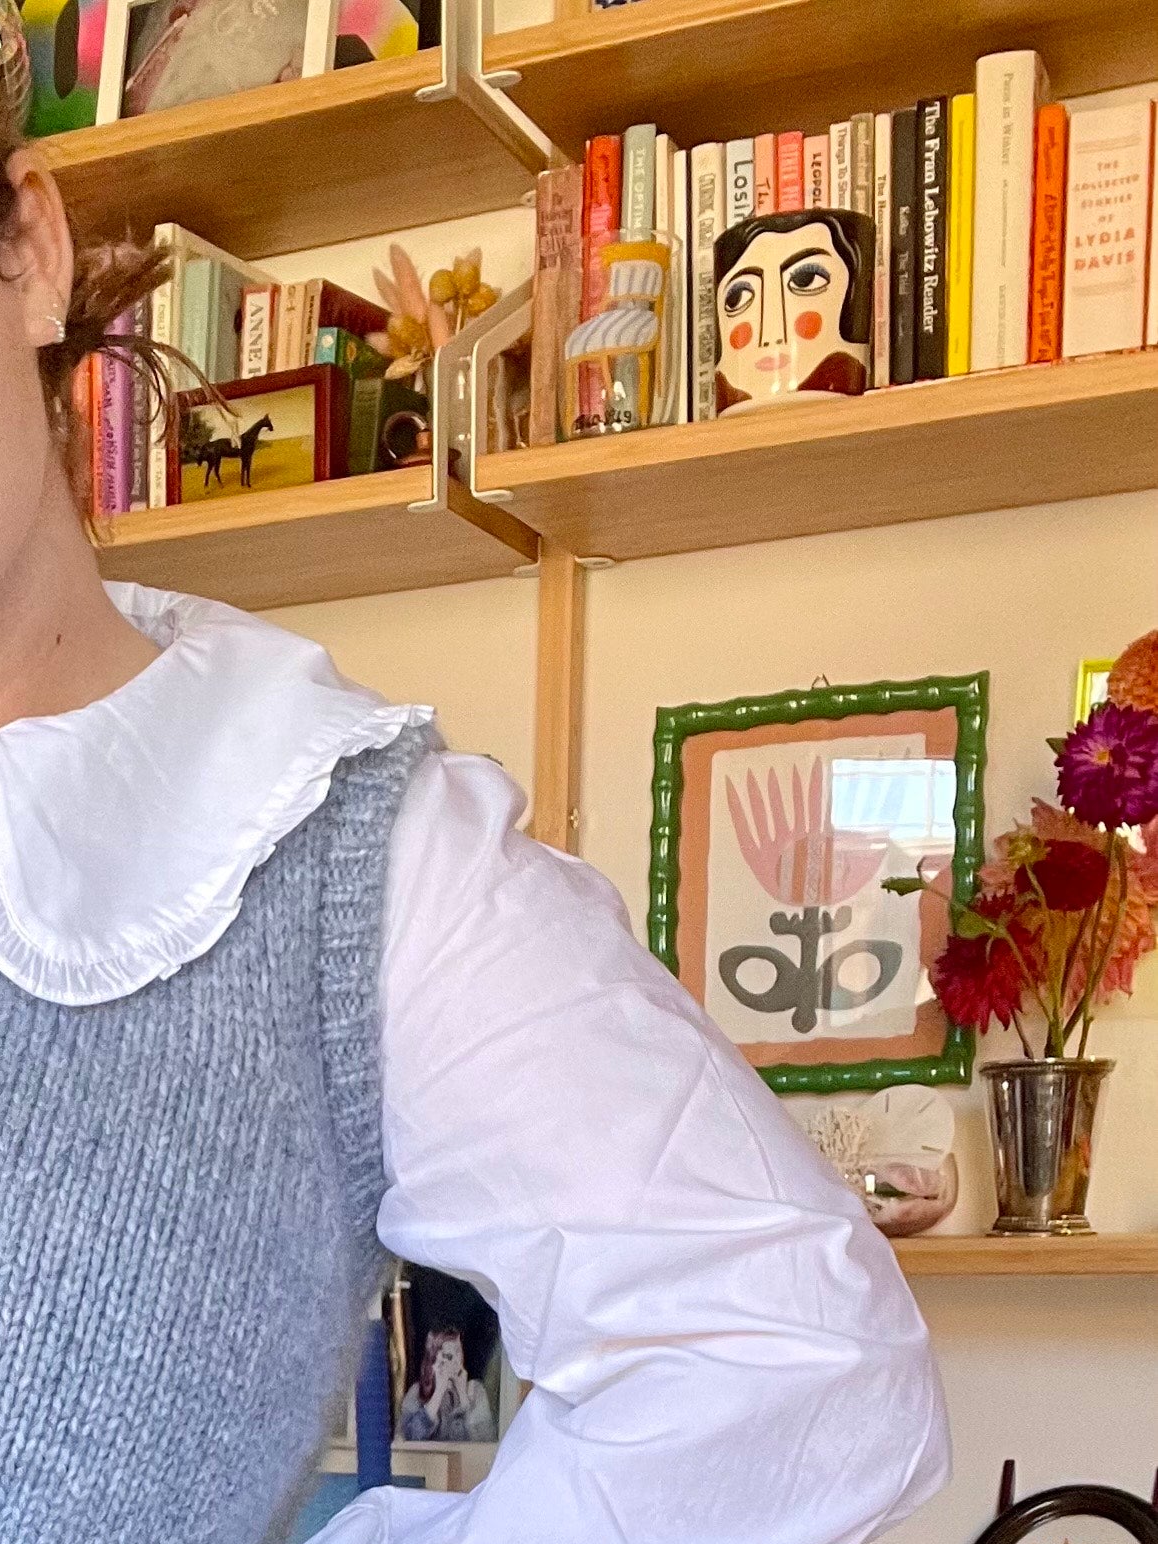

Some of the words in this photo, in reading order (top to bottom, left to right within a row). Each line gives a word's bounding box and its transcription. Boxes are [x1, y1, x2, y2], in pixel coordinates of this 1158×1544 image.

[924, 101, 940, 135] The
[924, 137, 940, 184] Fran
[923, 186, 940, 273] Lebowitz
[1074, 227, 1136, 249] LYDIA
[1073, 250, 1136, 271] DAVIS
[923, 274, 939, 334] Reader
[248, 301, 264, 362] ANNE
